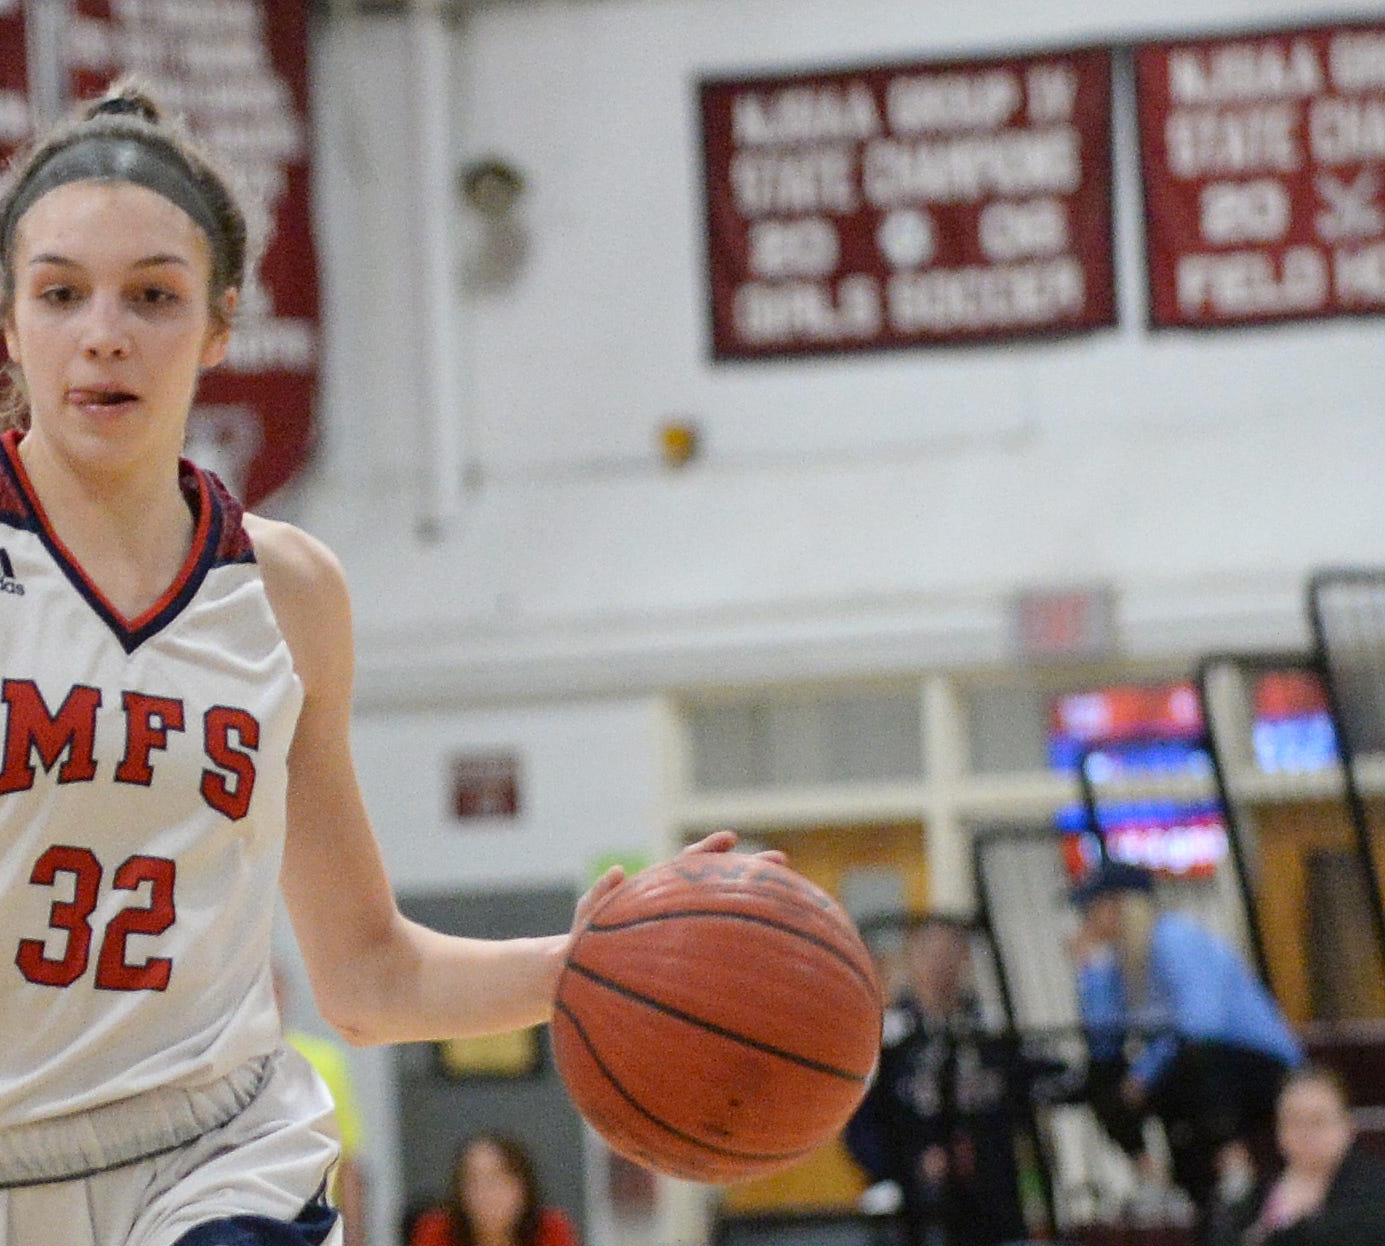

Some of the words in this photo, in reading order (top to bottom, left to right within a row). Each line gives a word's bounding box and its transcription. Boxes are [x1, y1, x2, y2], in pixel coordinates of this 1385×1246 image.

[730, 145, 859, 215] STATE
[863, 127, 1081, 208] CHAMPIONS
[1167, 105, 1299, 177] STATE
[748, 216, 838, 278] 20
[1200, 181, 1290, 242] 20
[732, 273, 881, 342] GIRLS
[887, 254, 1085, 332] SOCCER
[1175, 247, 1328, 314] FIELD
[15, 844, 177, 993] 32
